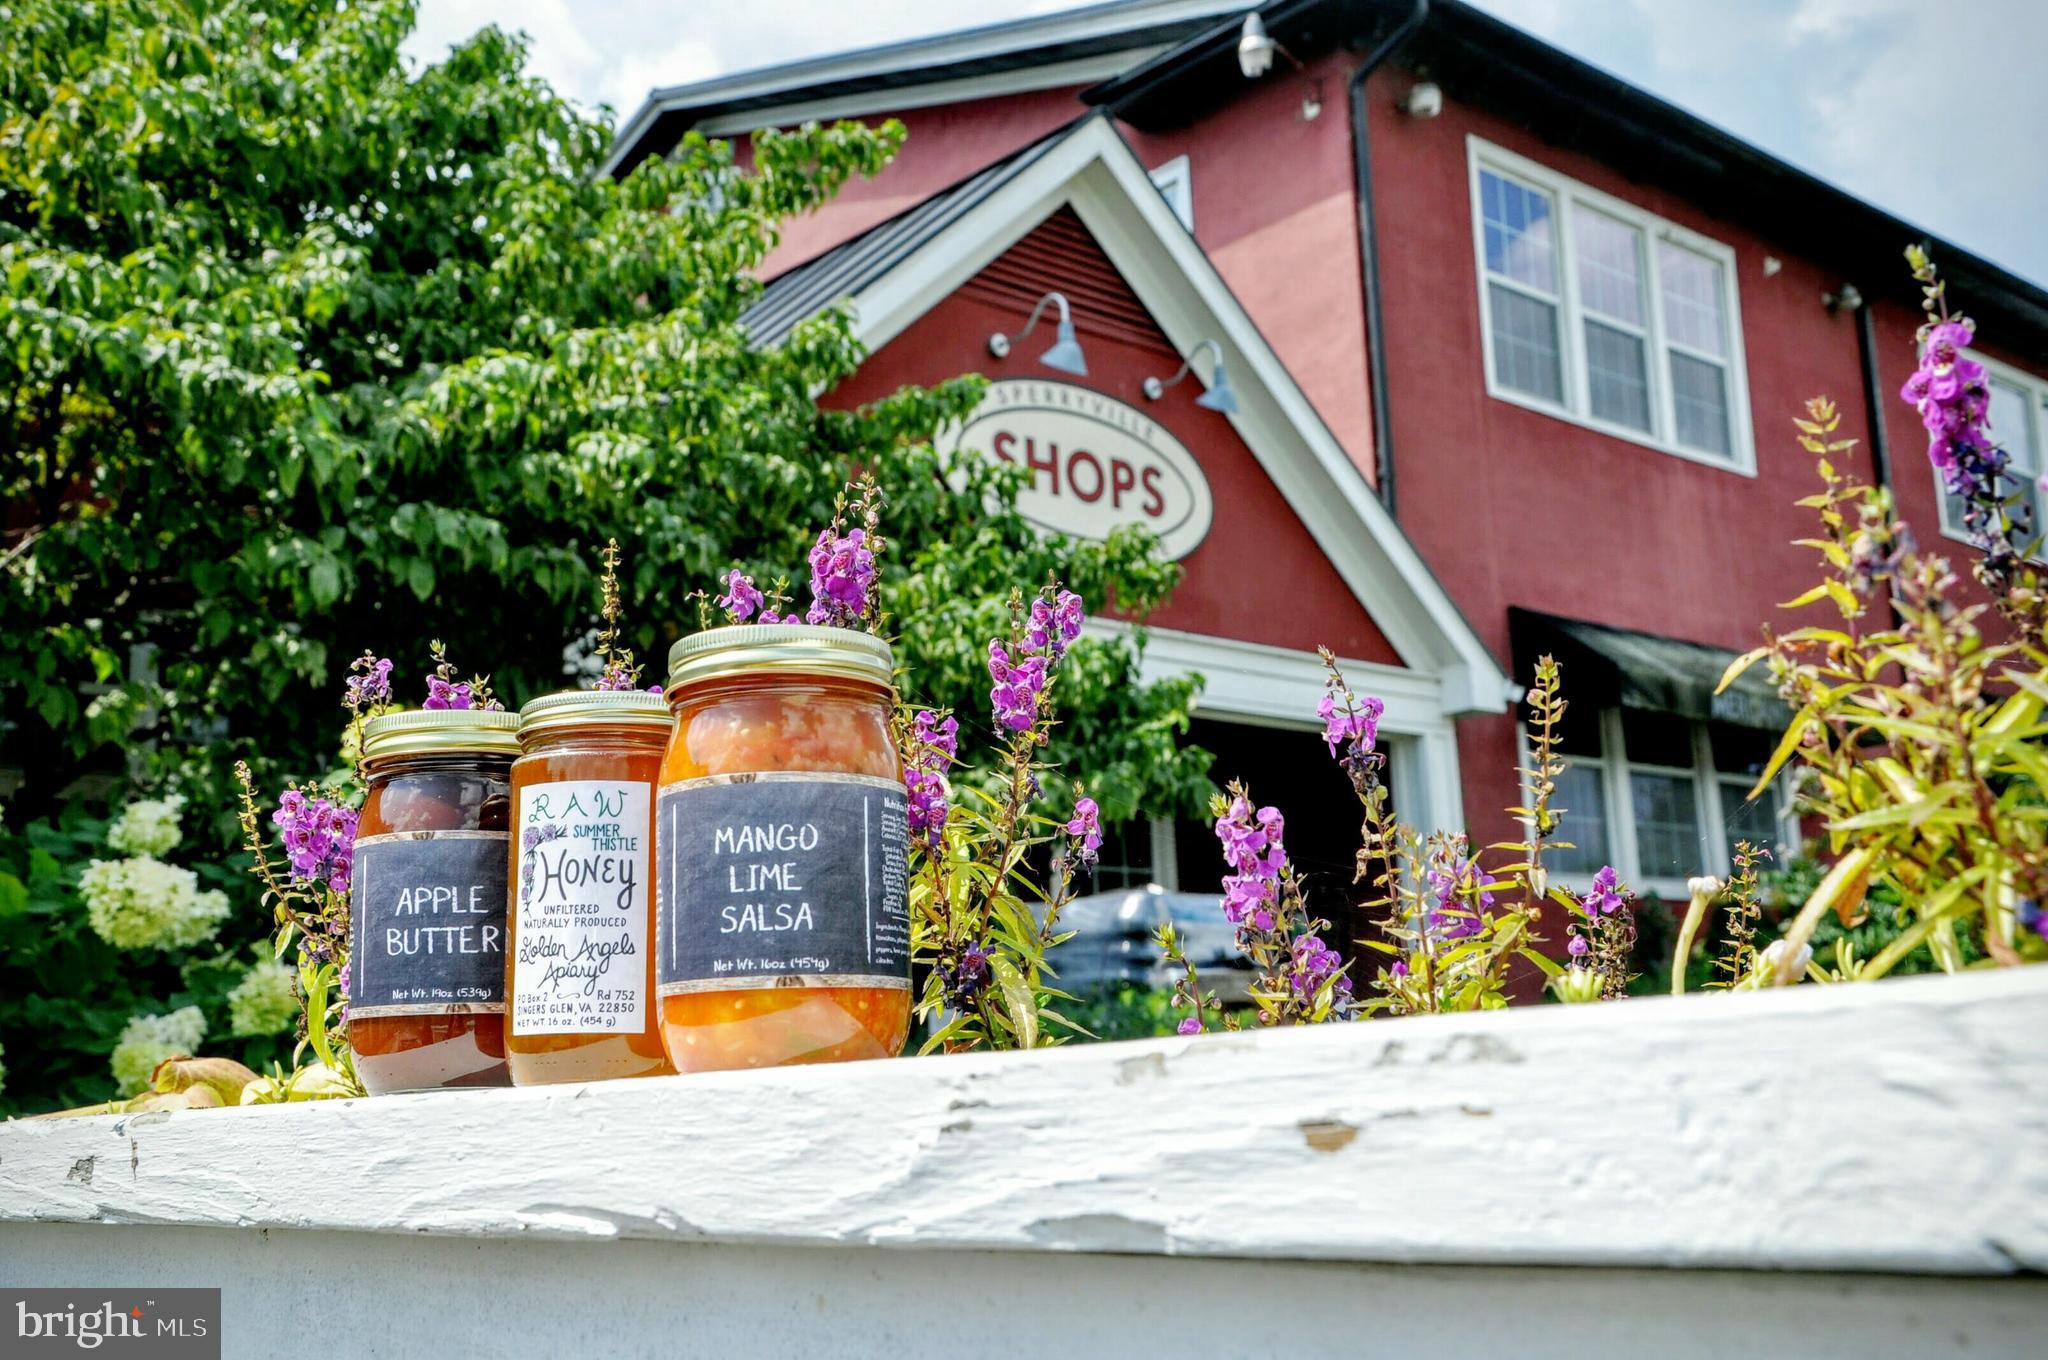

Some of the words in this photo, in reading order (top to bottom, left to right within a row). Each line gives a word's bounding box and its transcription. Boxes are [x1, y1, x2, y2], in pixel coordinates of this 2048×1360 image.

[993, 431, 1164, 517] SHOPS
[528, 790, 628, 822] RAW
[573, 824, 620, 838] SUMMER
[592, 837, 638, 851] THISTLE
[714, 823, 819, 855] MANGO
[729, 862, 802, 893] LIME
[395, 885, 489, 916] APPLE
[544, 904, 600, 915] UNFILTERED
[524, 918, 570, 929] NATURALLY
[574, 917, 627, 927] PRODUCED
[720, 902, 814, 934] SALSA
[386, 925, 500, 956] BUTTER
[519, 934, 569, 965] Golden
[570, 932, 636, 974] Angels
[713, 959, 733, 972] Net
[736, 958, 758, 970] Wt.
[760, 958, 785, 970] 16oz
[790, 957, 830, 972] (454g)
[537, 960, 600, 996] Apiary
[392, 989, 409, 1000] Net
[411, 988, 429, 999] Wt.
[431, 988, 453, 998] 19oz
[457, 987, 492, 999] (539g)
[528, 993, 540, 1003] Box
[543, 992, 548, 1002] 2
[597, 989, 611, 1000] Rd
[615, 990, 635, 1000] 752
[550, 1003, 577, 1015] GLEN,
[579, 1003, 592, 1013] VA
[599, 1002, 635, 1013] 22850
[548, 1017, 558, 1026] 16
[580, 1016, 602, 1027] (454
[606, 1016, 617, 1027] g)
